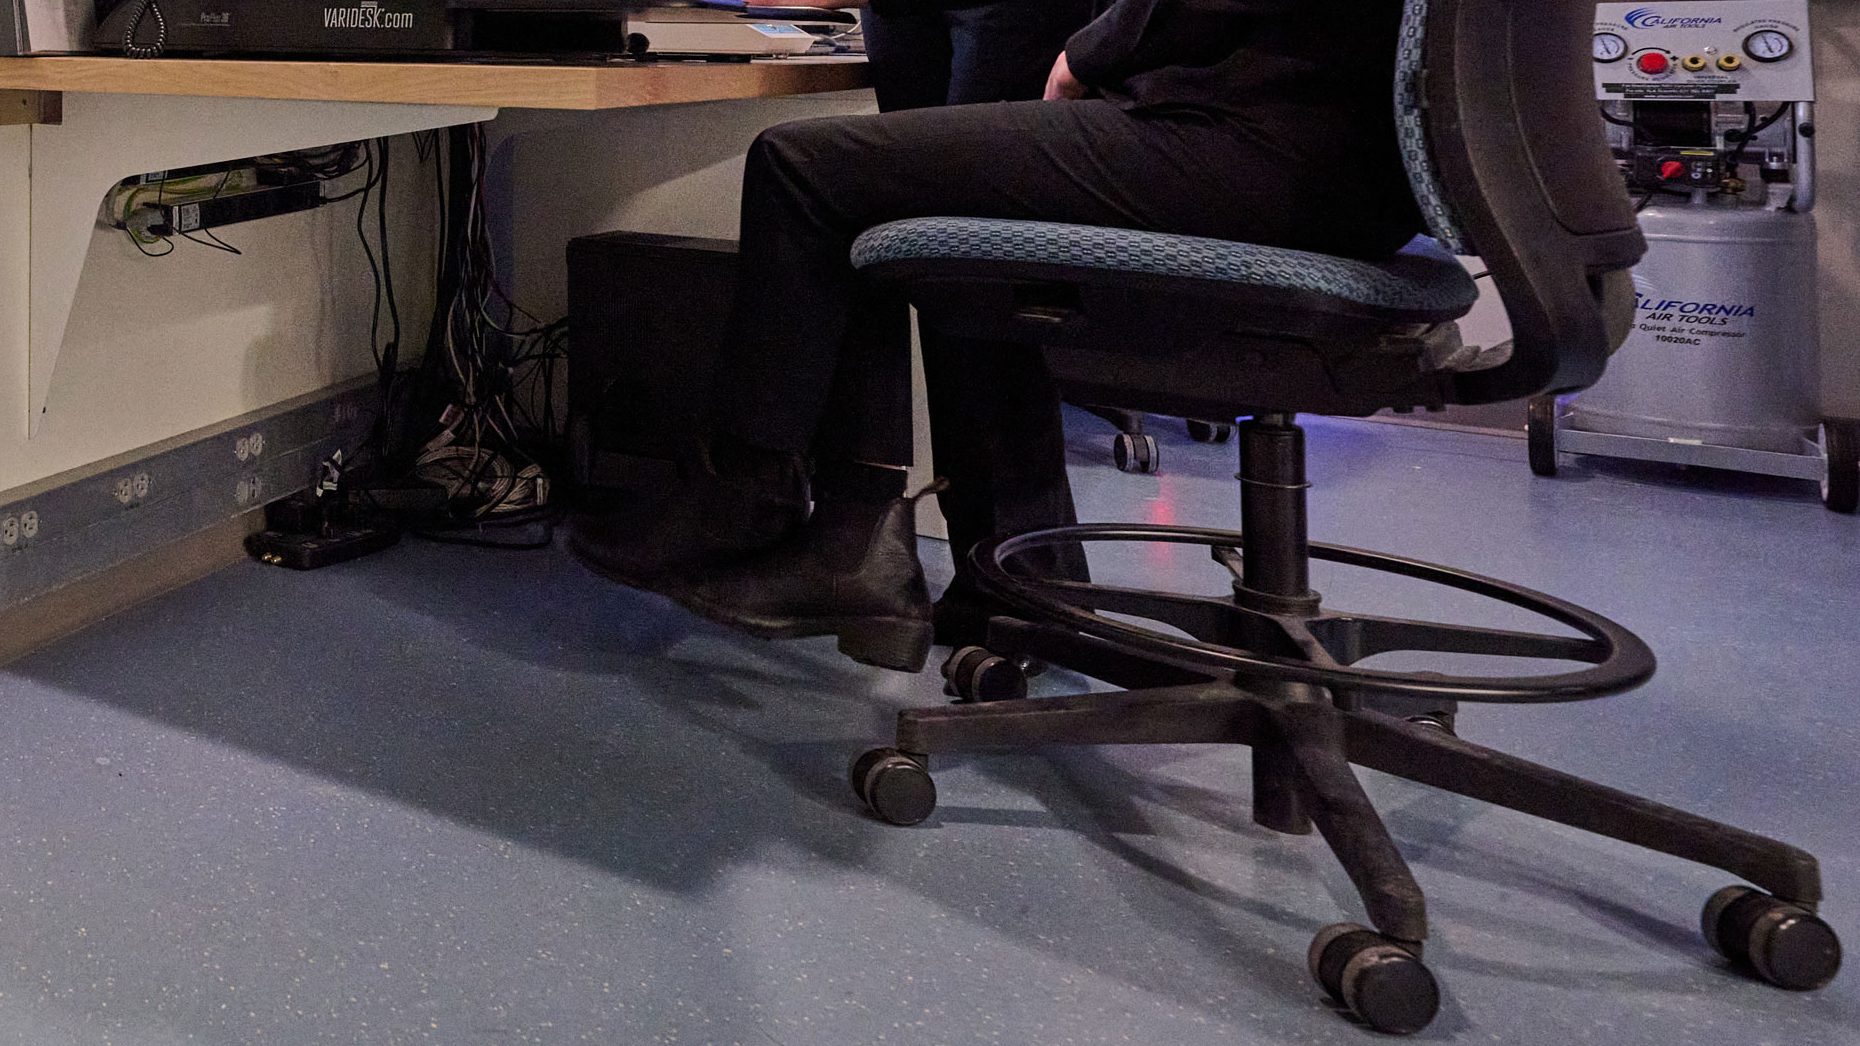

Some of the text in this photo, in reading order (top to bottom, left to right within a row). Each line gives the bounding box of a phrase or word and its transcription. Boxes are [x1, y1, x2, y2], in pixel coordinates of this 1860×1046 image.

[1641, 16, 1722, 27] CALIFORNIA
[1636, 292, 1756, 317] LIFORNIA
[1646, 312, 1728, 326] AIR TOOLS
[1639, 323, 1666, 333] Quiet
[1655, 334, 1701, 346] 10020AC
